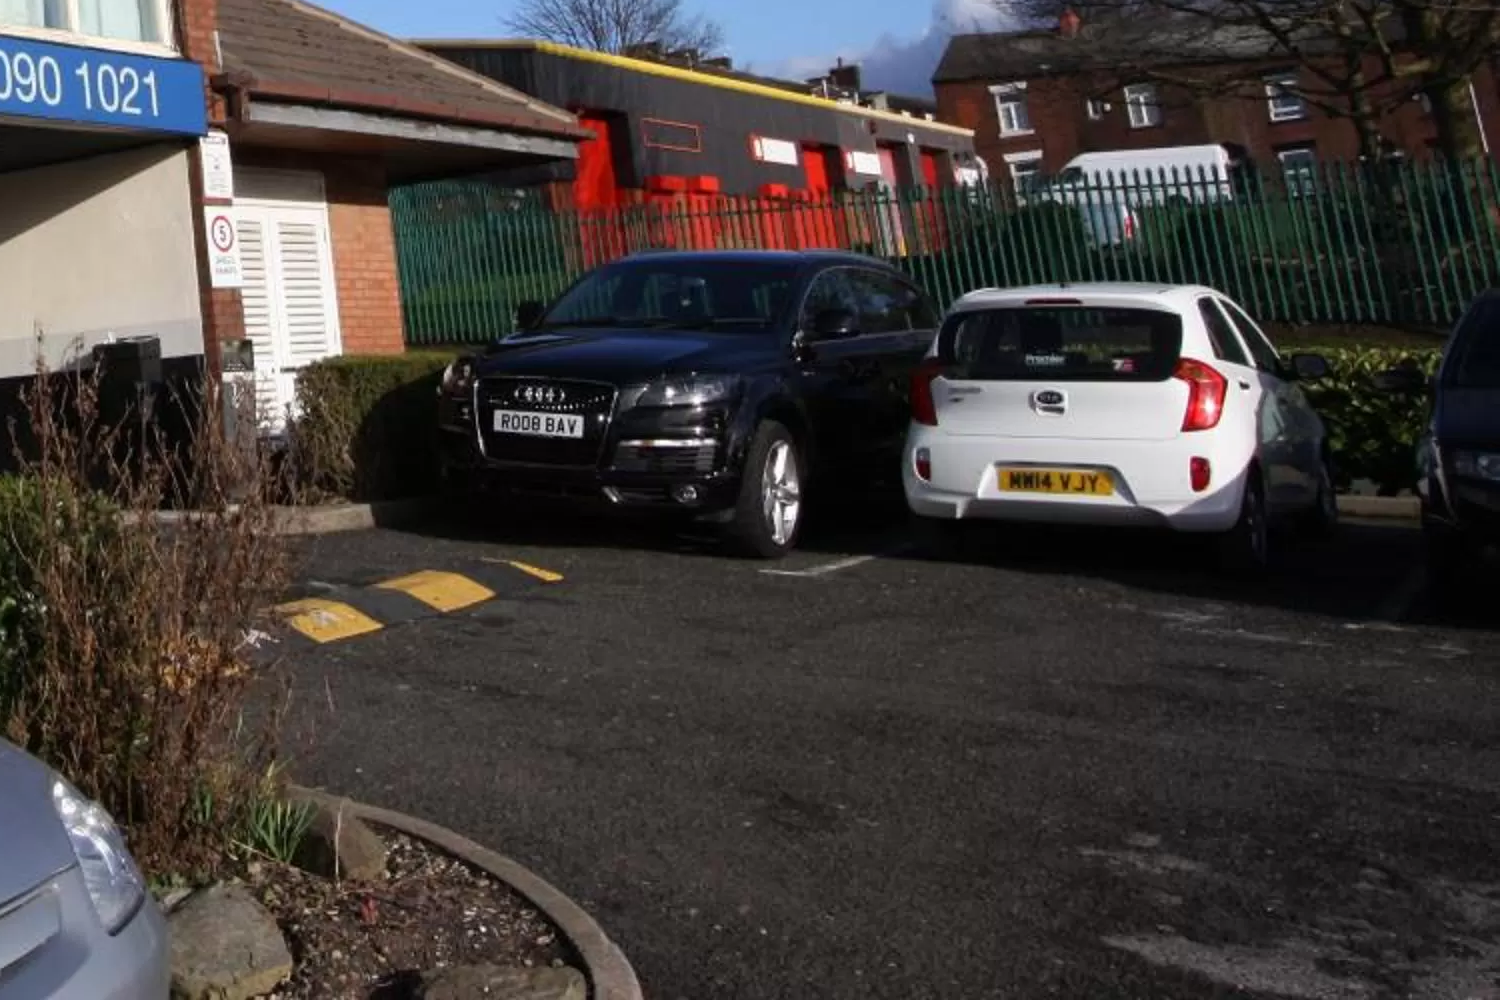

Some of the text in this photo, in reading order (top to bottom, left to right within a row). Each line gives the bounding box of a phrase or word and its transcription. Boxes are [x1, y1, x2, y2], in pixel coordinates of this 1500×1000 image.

[75, 61, 159, 117] 1021
[545, 417, 577, 435] BAV
[1060, 473, 1098, 492] VJY
